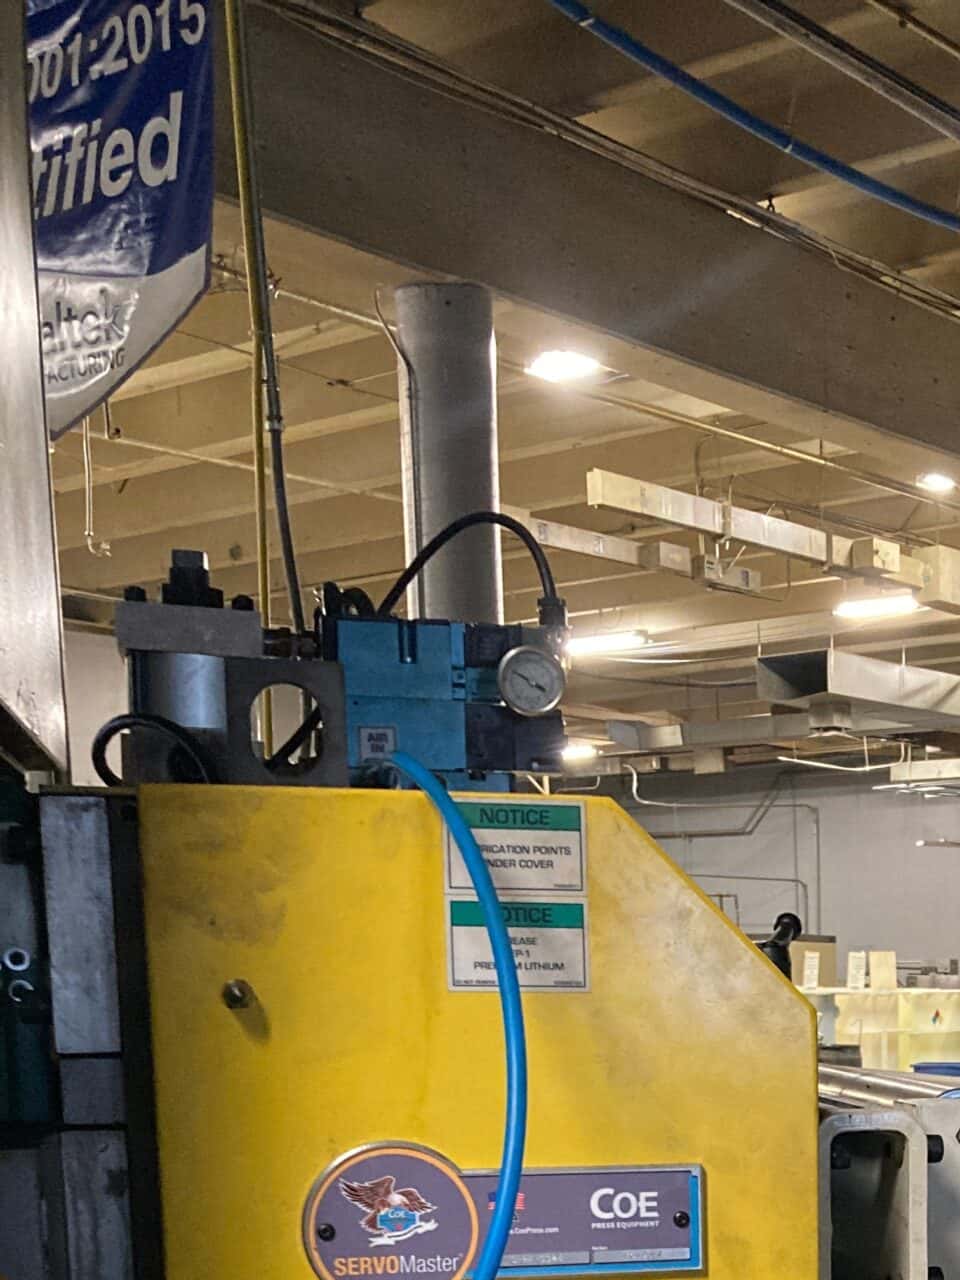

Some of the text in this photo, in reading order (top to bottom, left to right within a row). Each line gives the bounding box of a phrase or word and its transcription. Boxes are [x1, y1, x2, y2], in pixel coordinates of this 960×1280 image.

[32, 91, 184, 220] tified
[480, 808, 550, 826] NOTICE
[480, 844, 572, 856] RICATION POINTS
[487, 859, 554, 869] NDER COVER
[503, 907, 554, 924] OTICE
[511, 937, 537, 946] EASE
[524, 961, 565, 971] LITHIUM
[589, 1187, 660, 1220] COE
[591, 1220, 660, 1230] PRESS EQUIPMENT
